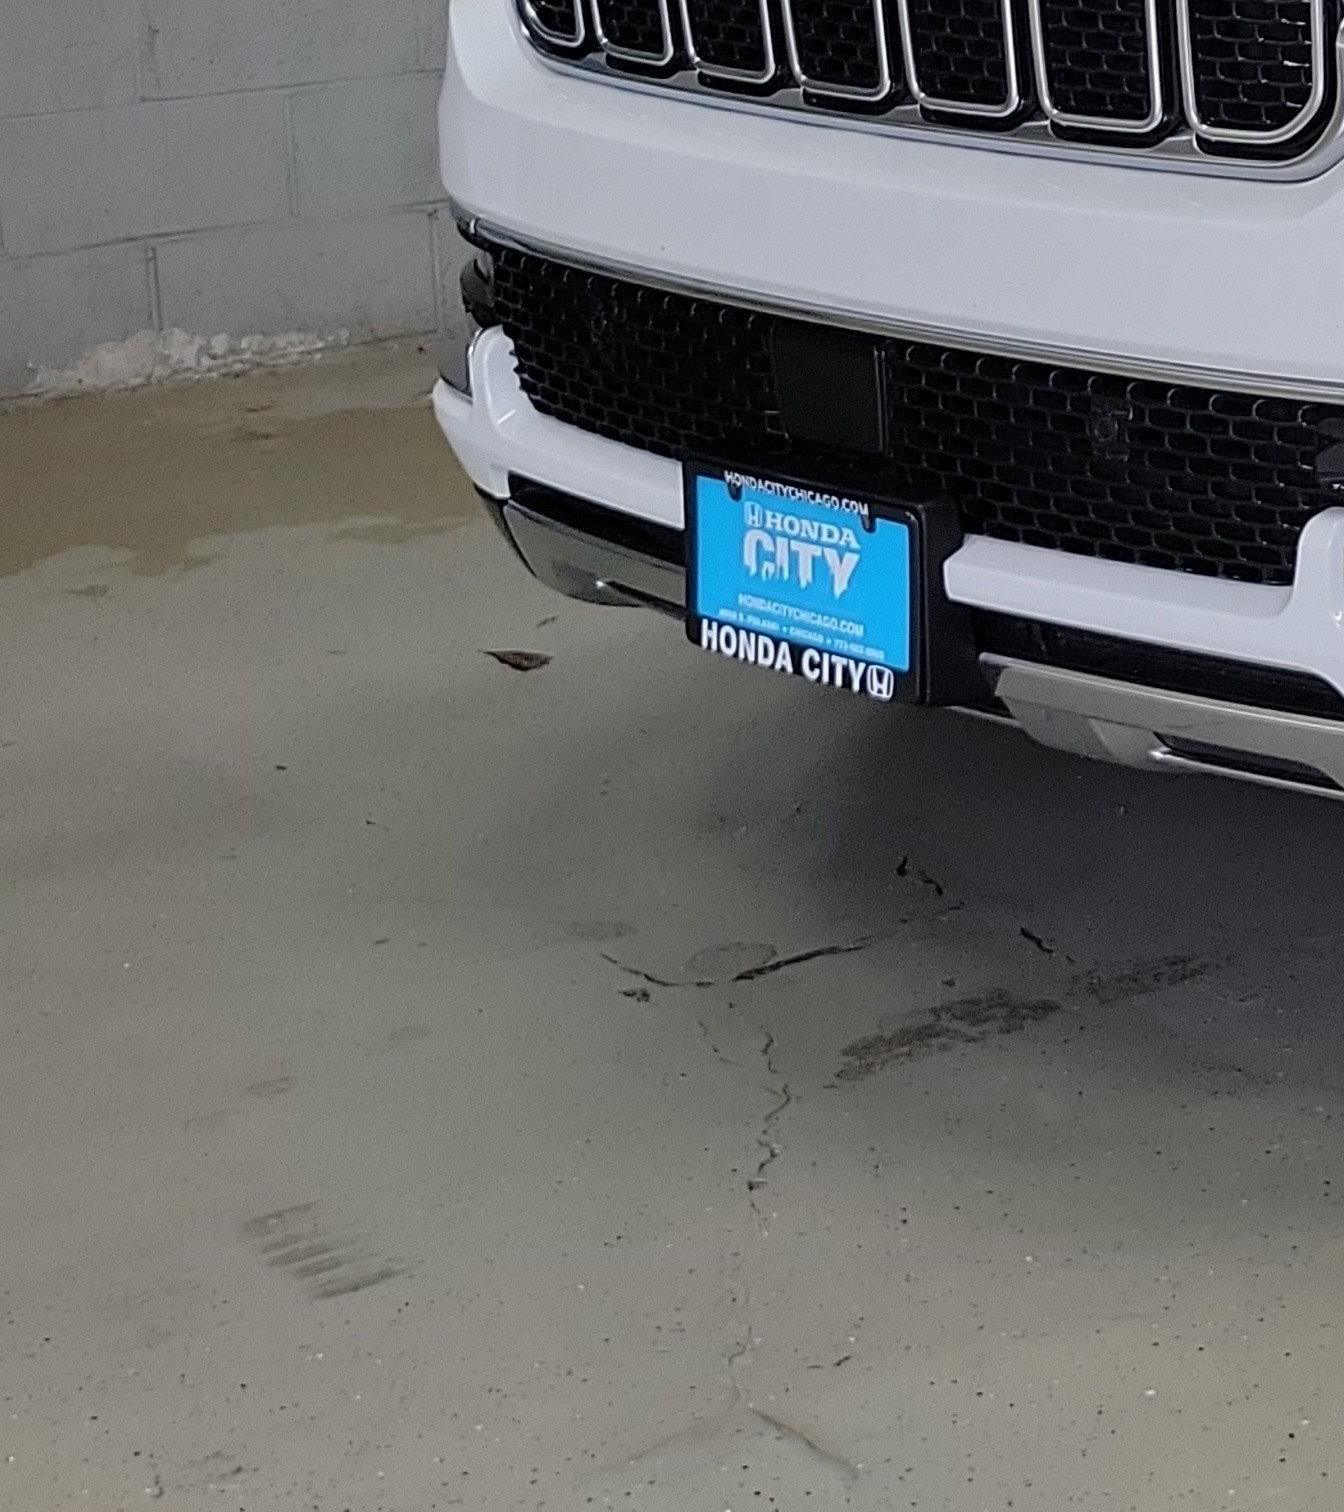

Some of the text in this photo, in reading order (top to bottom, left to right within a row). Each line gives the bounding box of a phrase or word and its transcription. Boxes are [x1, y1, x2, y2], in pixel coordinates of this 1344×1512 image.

[724, 469, 870, 517] HONDACITYCHICAGO.COM
[763, 508, 861, 550] HONDA
[743, 528, 861, 600] CITY
[737, 593, 865, 637] HONDACITYCHICAGO.COM
[701, 618, 794, 675] HONDA
[801, 647, 867, 694] CITY
